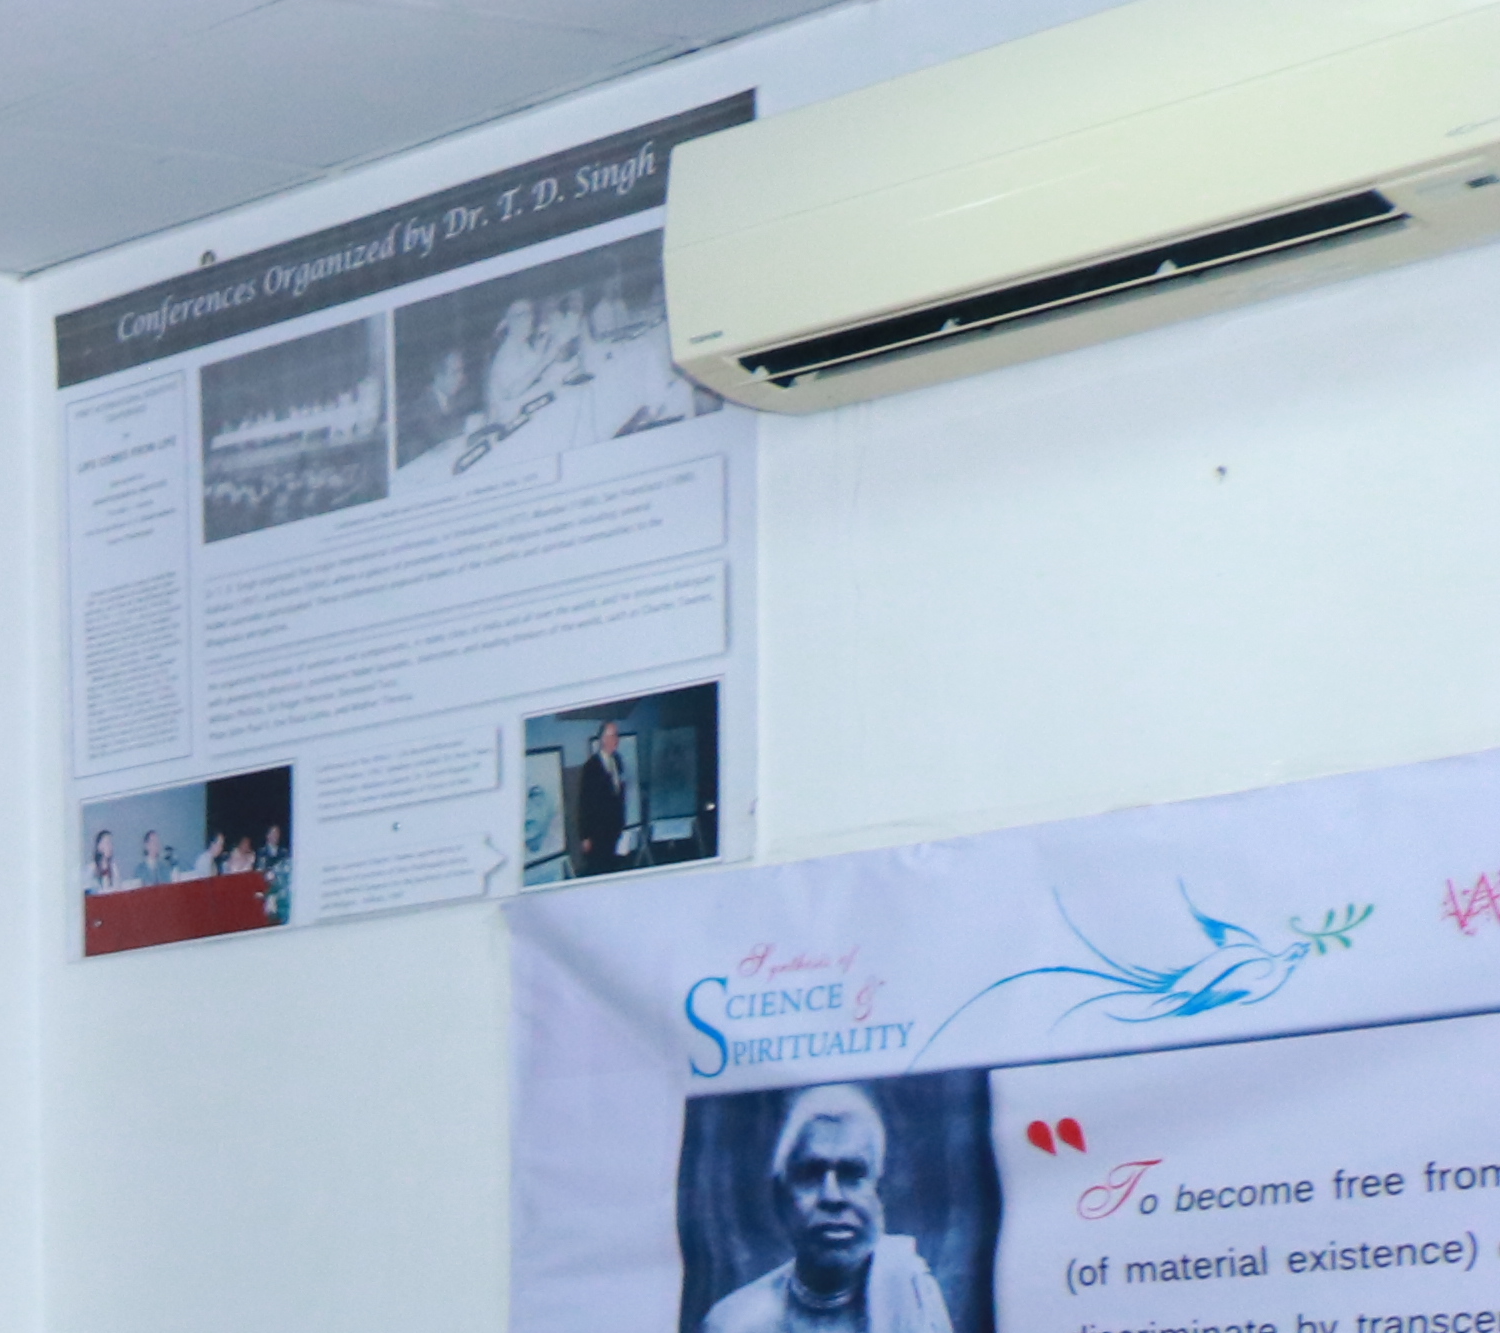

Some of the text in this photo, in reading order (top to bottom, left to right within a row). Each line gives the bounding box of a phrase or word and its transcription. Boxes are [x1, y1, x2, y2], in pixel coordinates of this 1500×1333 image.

[116, 141, 657, 343] Conferences Organized by Dr. T. D. Singh
[685, 976, 843, 1036] SCIENCE
[687, 1020, 915, 1078] SPIRITUALITY
[1077, 1158, 1162, 1220] To
[1176, 1180, 1314, 1214] become
[1333, 1169, 1405, 1199] free
[1065, 1232, 1479, 1295] (of material existence)
